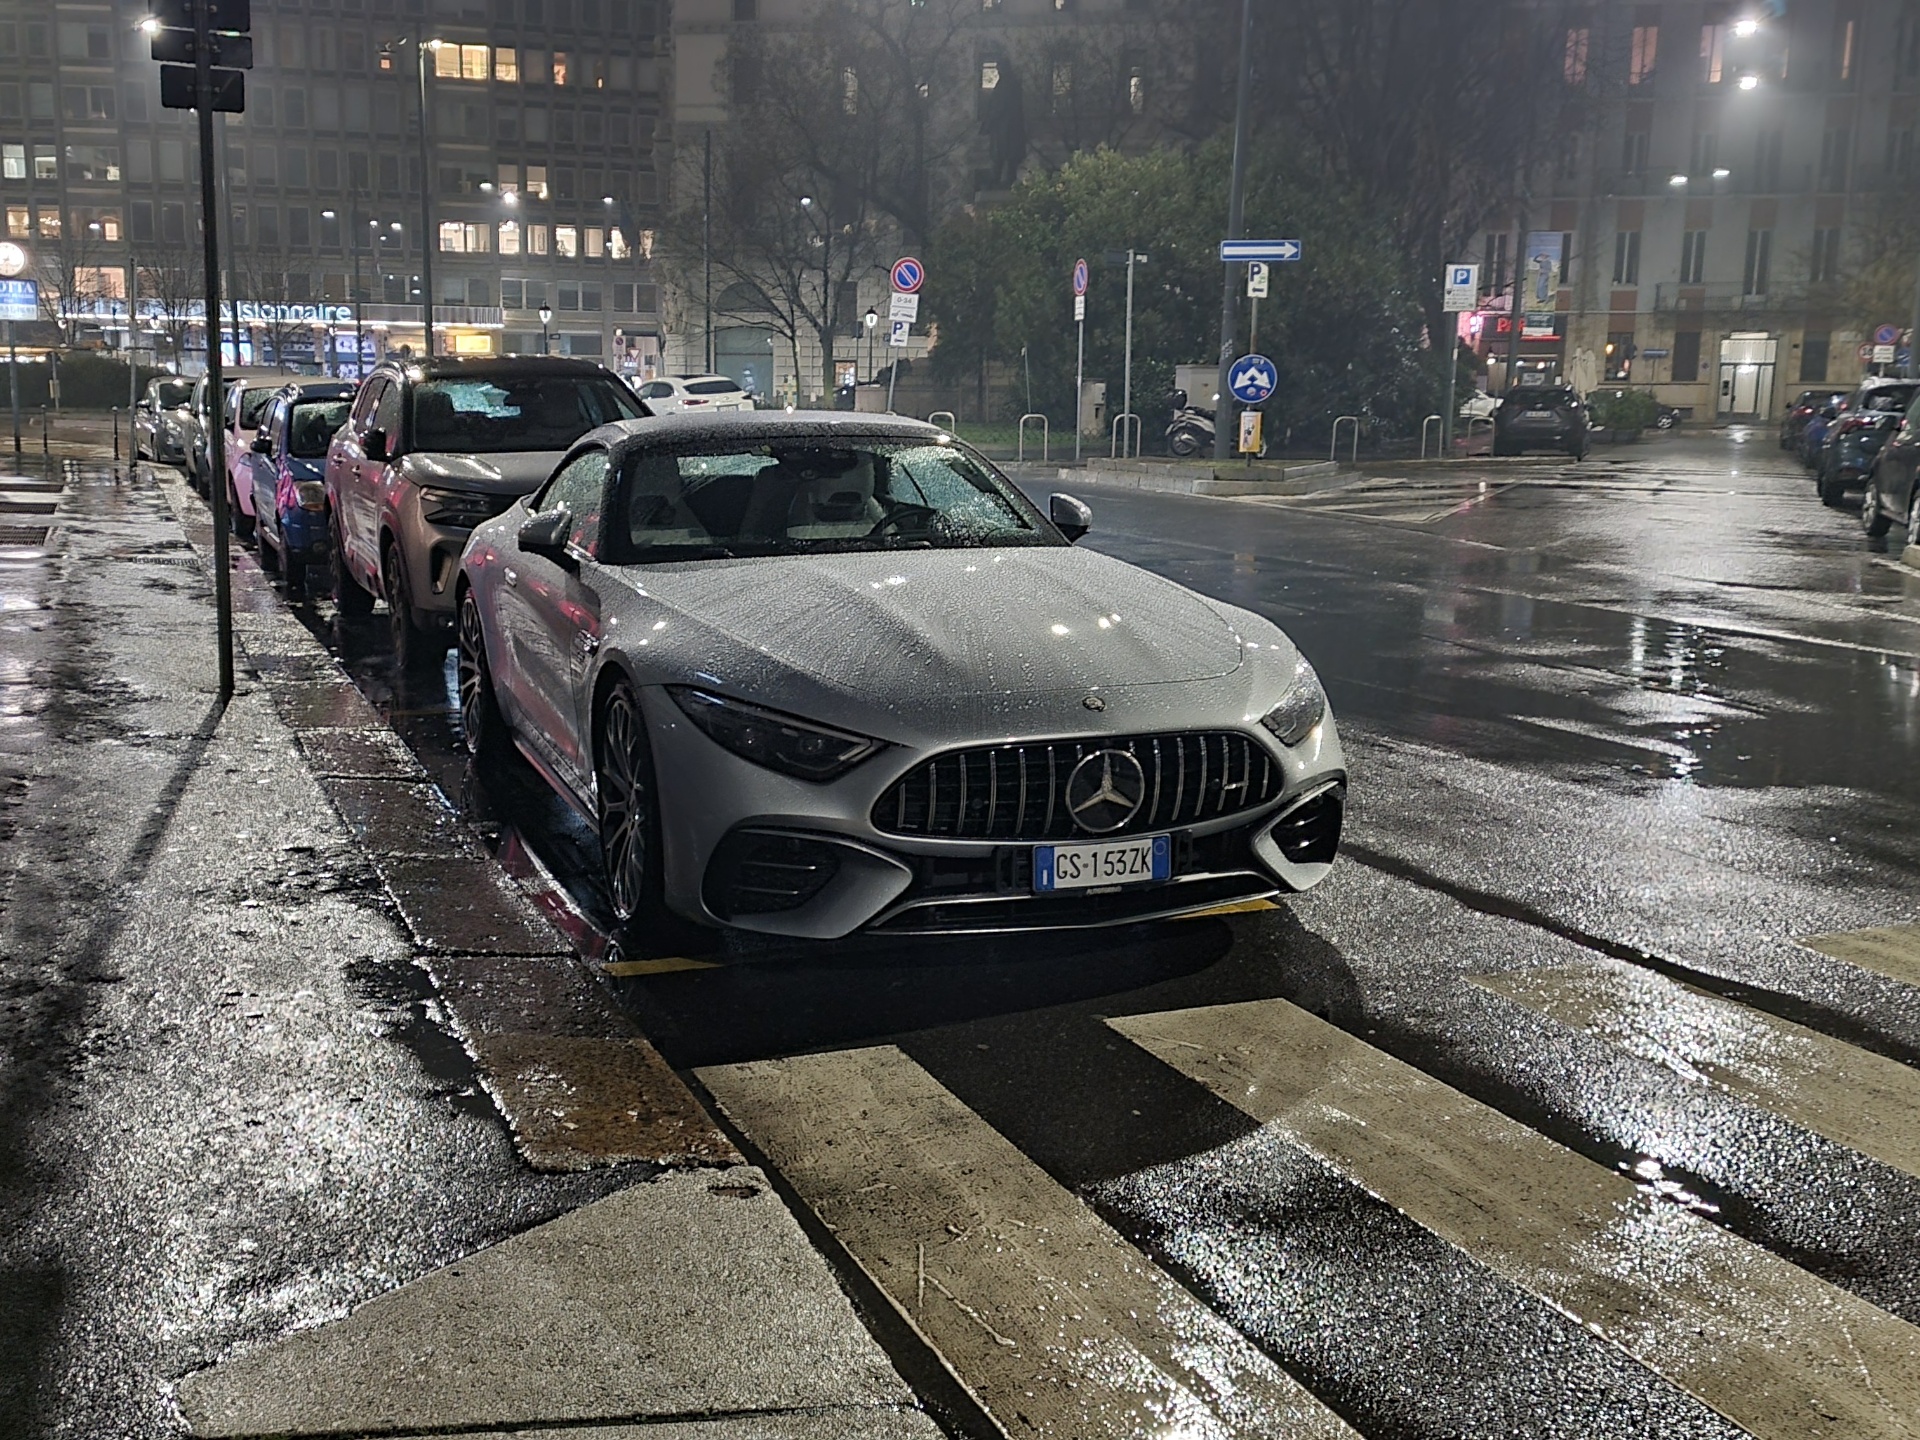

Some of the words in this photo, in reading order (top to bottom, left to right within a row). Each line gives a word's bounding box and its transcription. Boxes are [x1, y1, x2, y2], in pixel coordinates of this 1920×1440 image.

[1250, 263, 1262, 282] P
[1456, 269, 1468, 284] P
[893, 321, 904, 335] P
